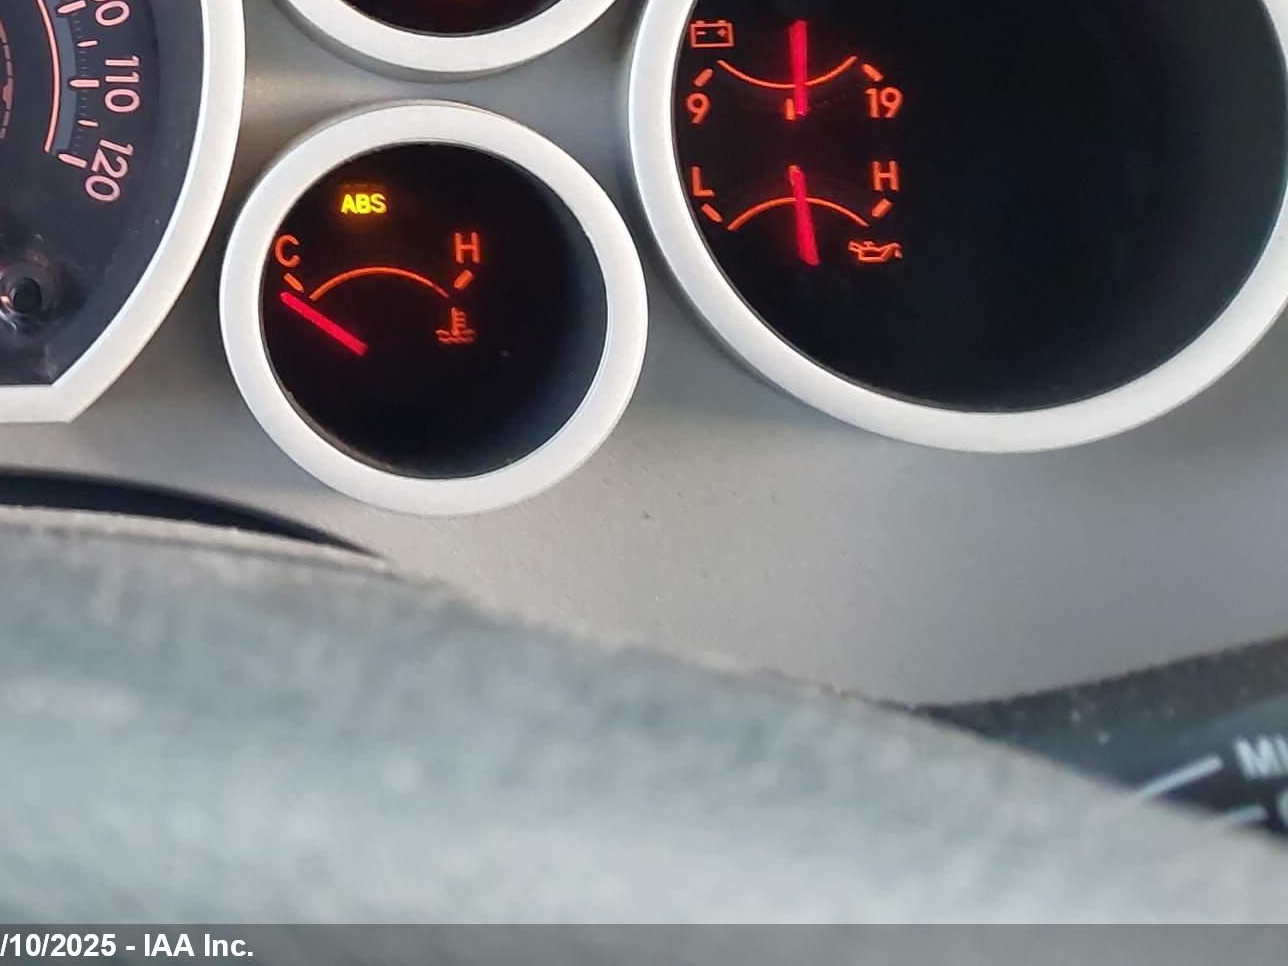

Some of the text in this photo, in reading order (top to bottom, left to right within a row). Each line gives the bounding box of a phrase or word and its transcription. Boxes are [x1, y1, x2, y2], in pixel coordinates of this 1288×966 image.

[104, 55, 140, 113] 110
[686, 92, 710, 124] 9
[865, 86, 903, 118] 19
[85, 139, 134, 202] 120
[691, 166, 715, 197] L
[872, 160, 899, 191] H
[340, 193, 387, 215] ABS
[274, 234, 301, 268] C
[454, 232, 480, 264] H
